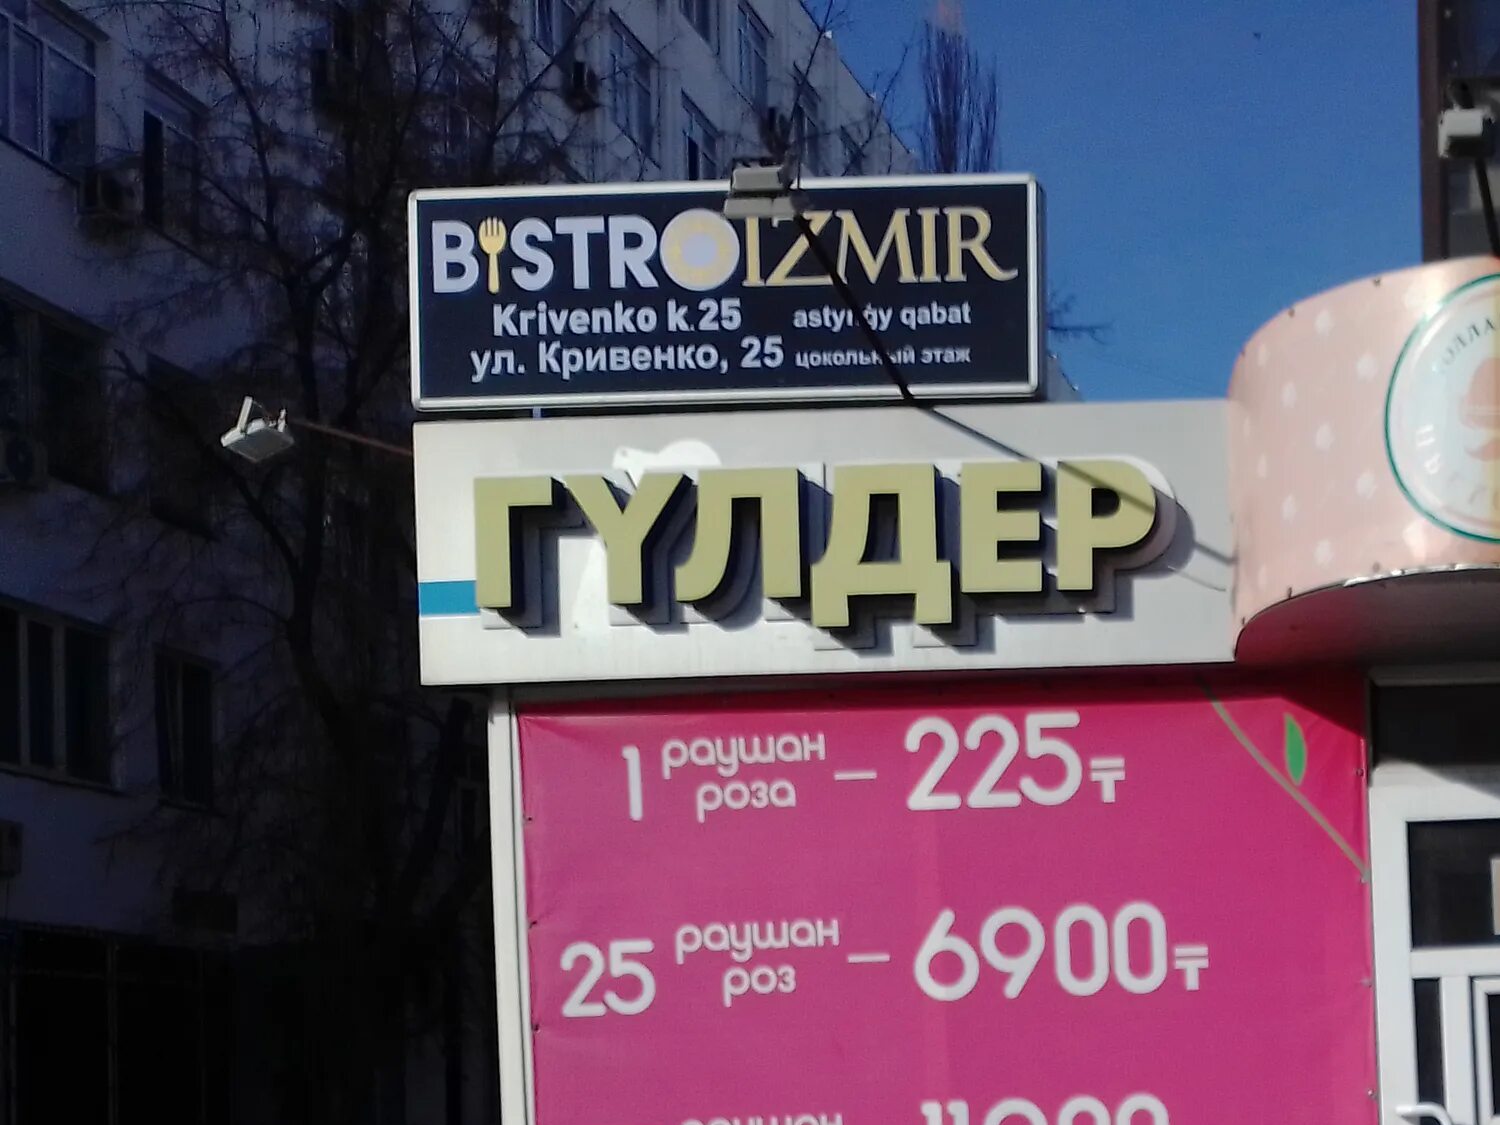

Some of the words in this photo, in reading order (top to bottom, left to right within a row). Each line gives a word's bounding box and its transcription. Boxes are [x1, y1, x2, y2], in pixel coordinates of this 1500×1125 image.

[492, 300, 657, 336] Krivenko
[900, 301, 972, 330] qabat
[470, 350, 526, 383] ул.
[538, 339, 729, 380] Кривенко,
[740, 335, 785, 368] 25
[920, 347, 972, 364] этаж
[622, 746, 643, 821] 1
[661, 733, 827, 779] раушан
[696, 780, 797, 823] роза
[559, 938, 657, 1018] 25
[674, 918, 840, 965] раушан
[722, 964, 797, 1008] роз
